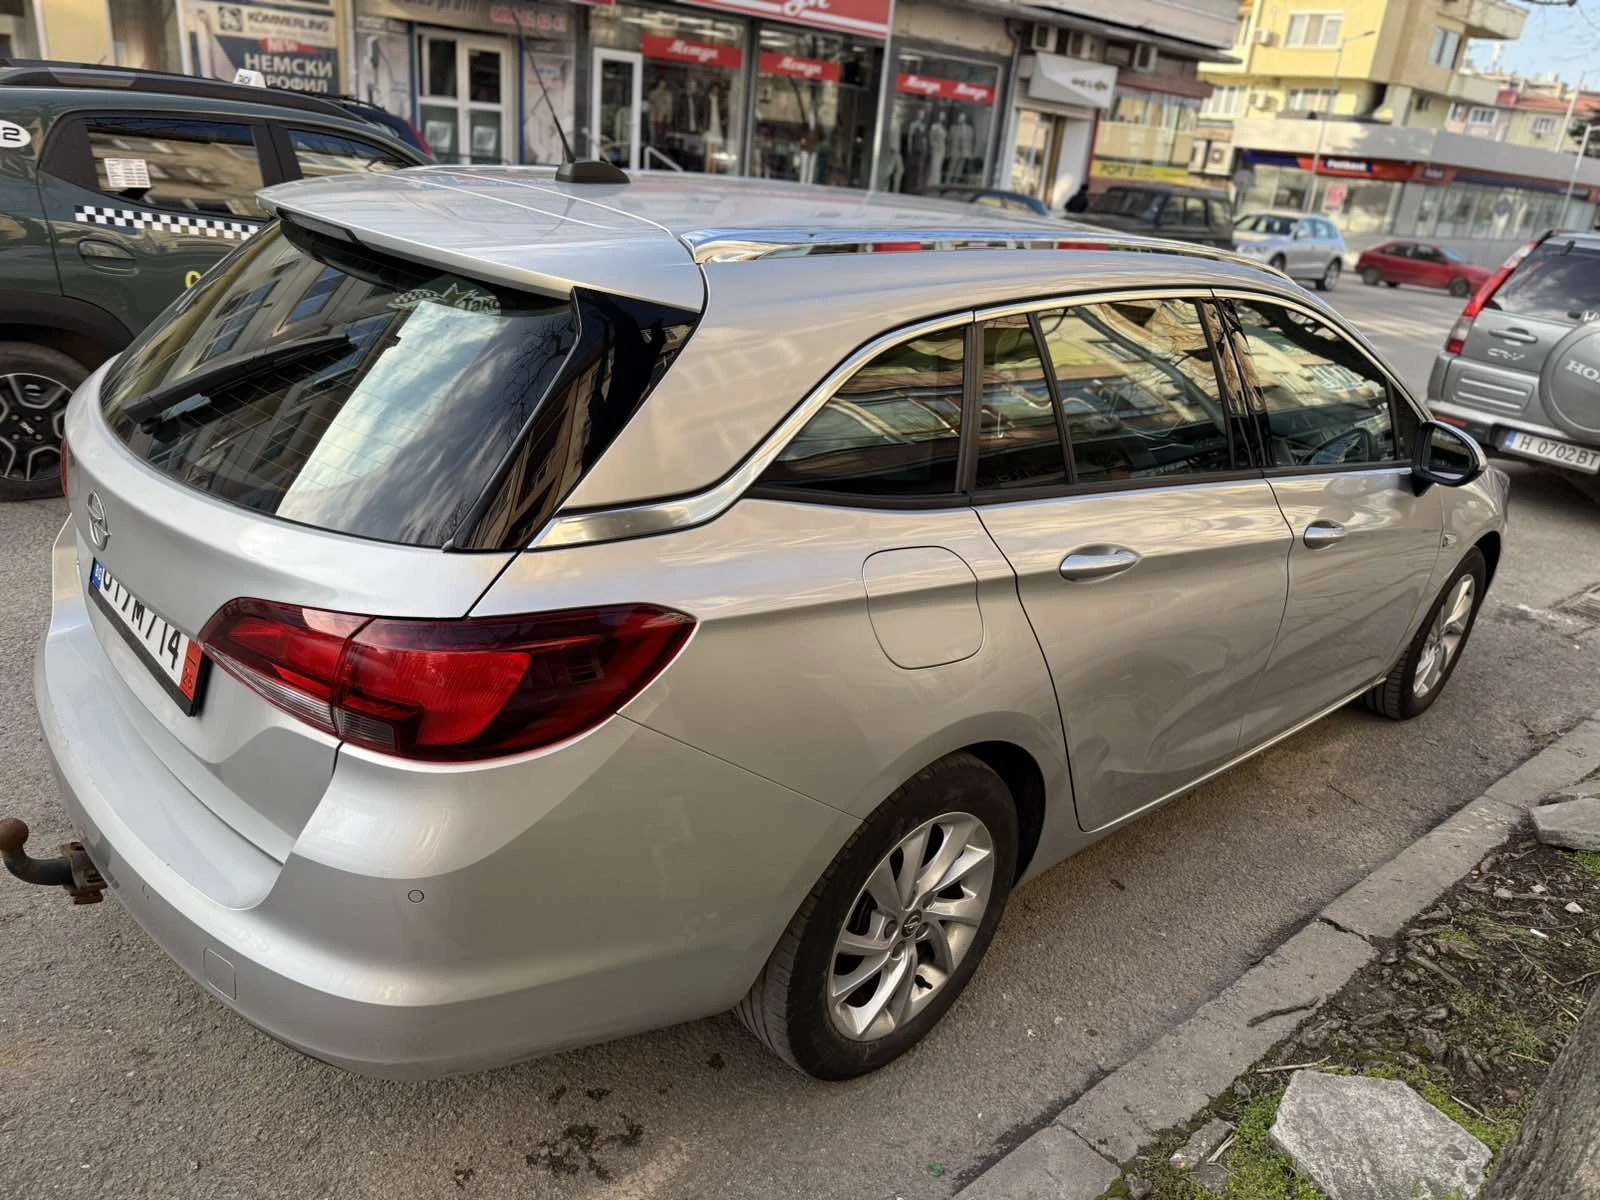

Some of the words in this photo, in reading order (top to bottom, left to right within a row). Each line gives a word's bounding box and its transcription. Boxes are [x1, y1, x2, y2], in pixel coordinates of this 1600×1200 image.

[243, 53, 333, 78] НЕМСКИ
[266, 74, 328, 93] РОФИЛ
[1519, 434, 1533, 450] H
